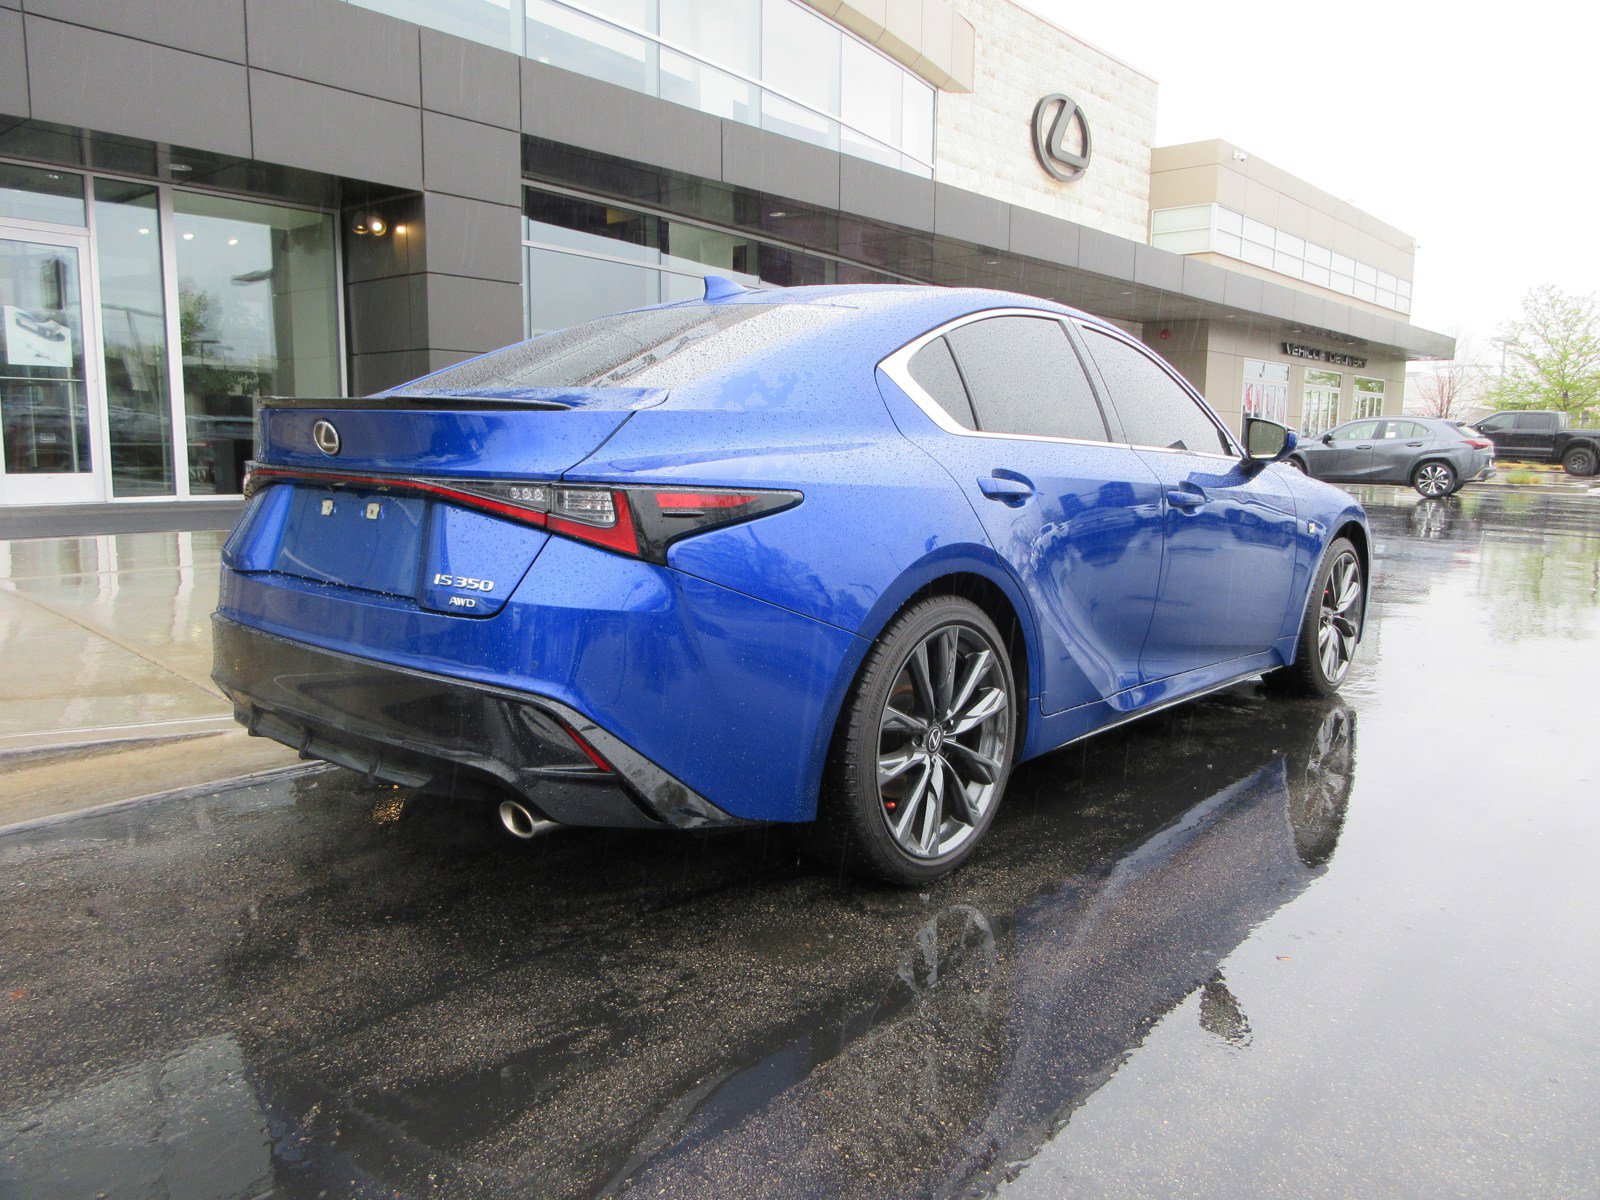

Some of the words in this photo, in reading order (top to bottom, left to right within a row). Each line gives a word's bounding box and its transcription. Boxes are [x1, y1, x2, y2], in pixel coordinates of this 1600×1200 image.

[434, 573, 453, 586] IS
[453, 576, 494, 592] 350
[449, 596, 476, 608] AWD
